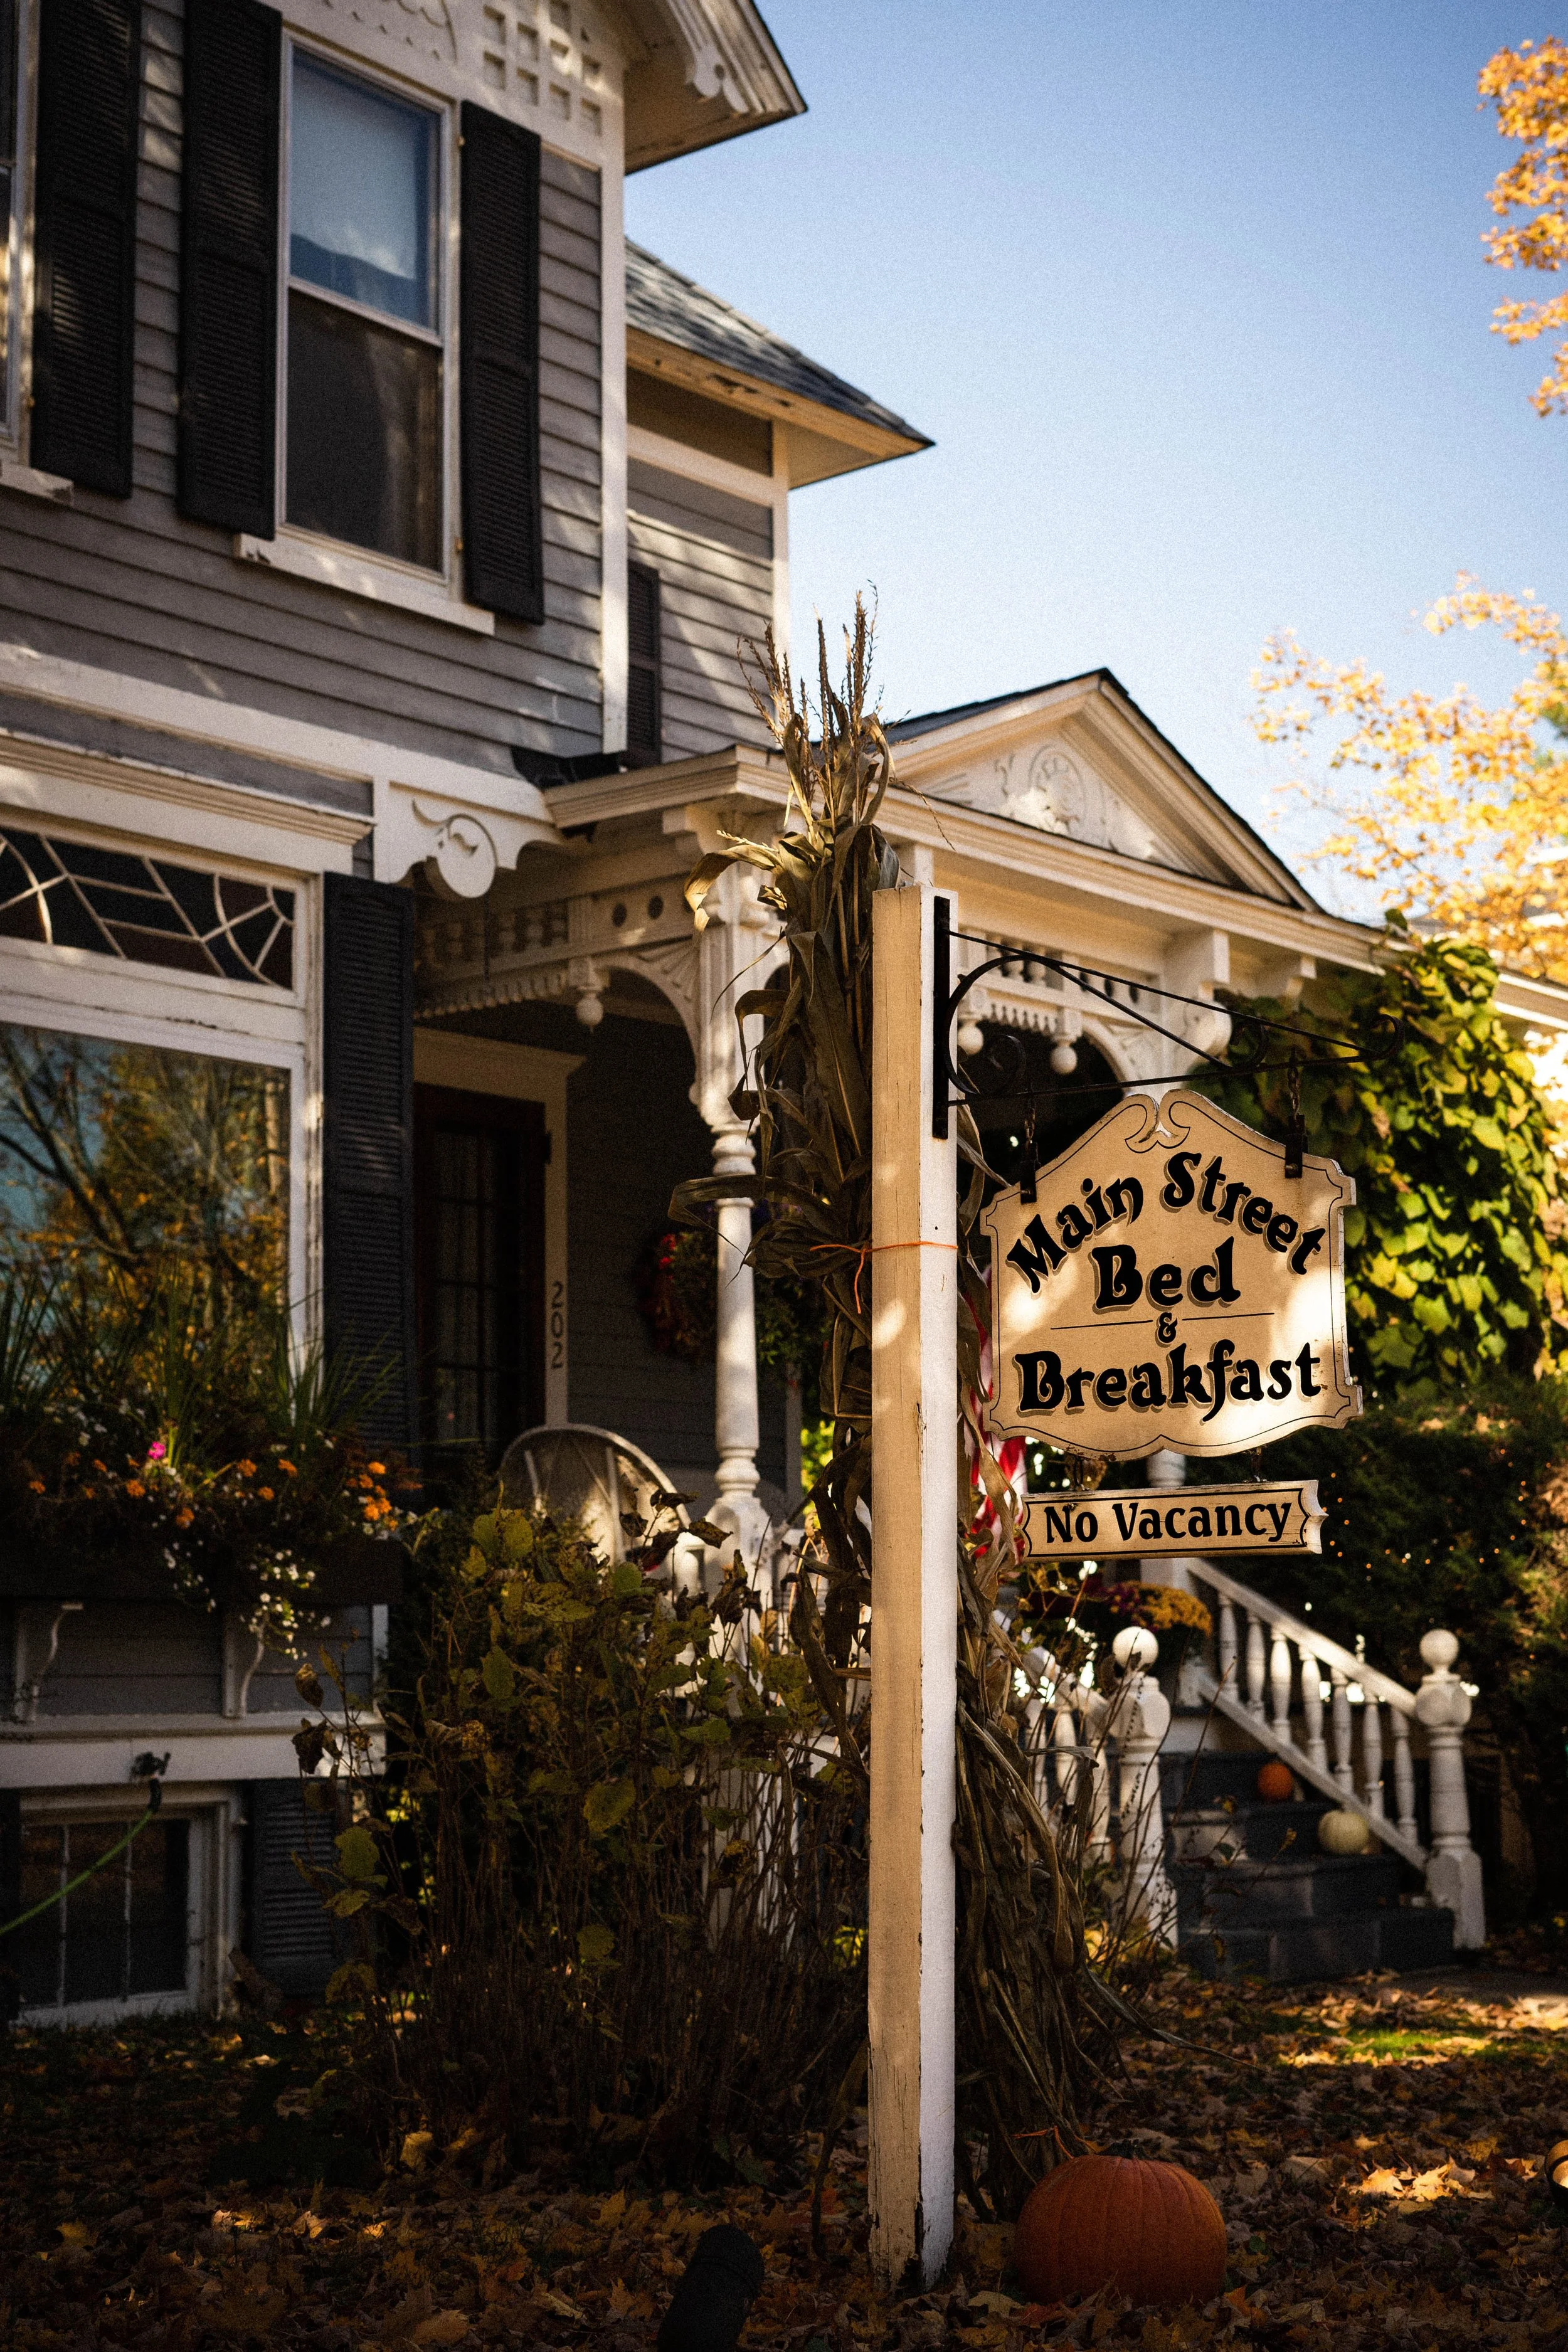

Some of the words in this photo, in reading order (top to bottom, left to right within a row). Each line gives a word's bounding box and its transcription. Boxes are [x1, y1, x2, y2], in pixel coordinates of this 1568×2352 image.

[1006, 1177, 1144, 1293] Main
[1161, 1152, 1326, 1275] Street
[1090, 1236, 1241, 1315] Bed
[551, 1280, 563, 1369] 202
[1155, 1311, 1178, 1347] &
[1014, 1338, 1322, 1424] Breakfast
[1044, 1506, 1098, 1544] No
[1112, 1501, 1291, 1542] Vacancy
